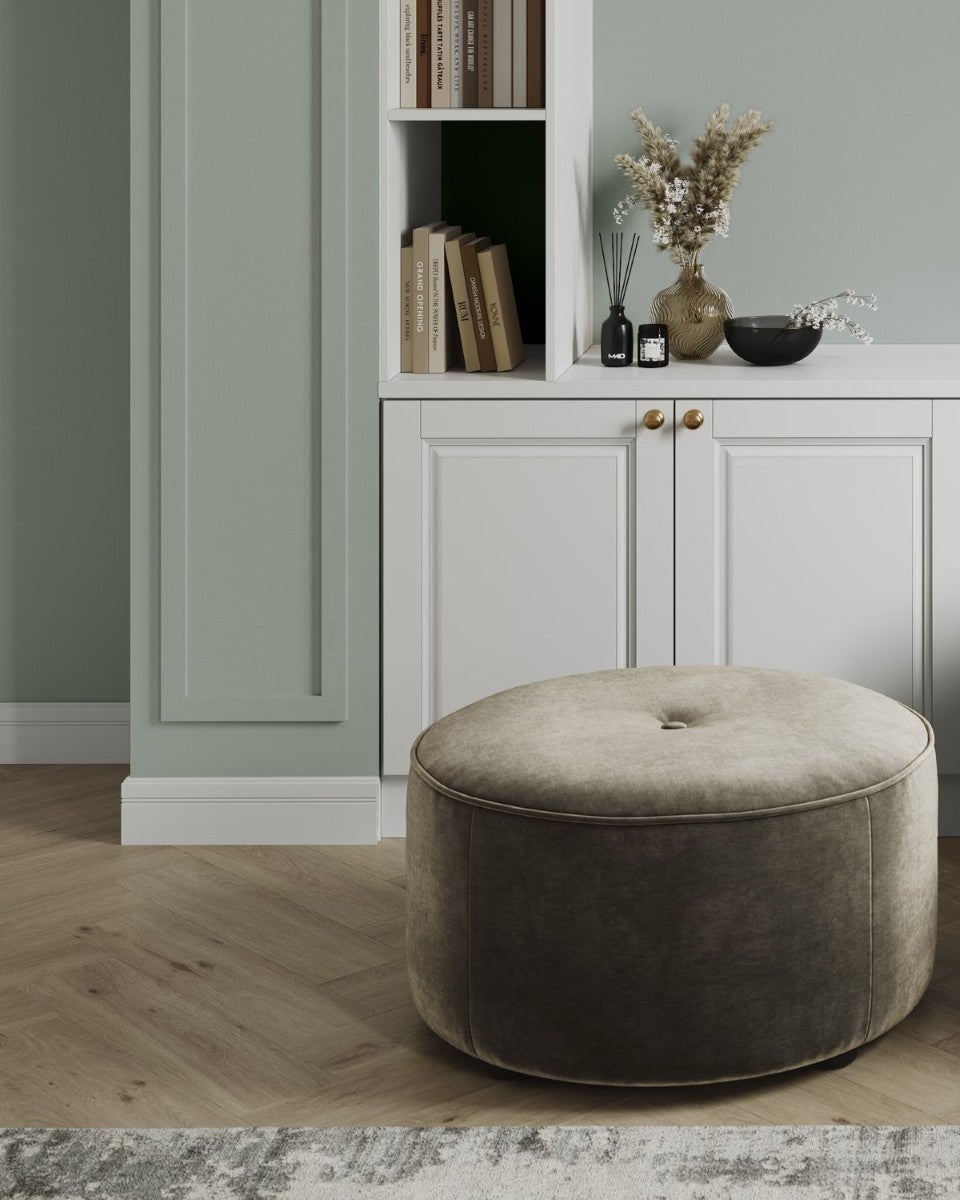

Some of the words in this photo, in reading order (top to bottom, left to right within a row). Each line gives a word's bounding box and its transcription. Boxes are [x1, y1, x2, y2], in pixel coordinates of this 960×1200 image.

[458, 301, 468, 322] RUM
[473, 298, 481, 319] MODERN
[476, 320, 486, 339] DESIGN
